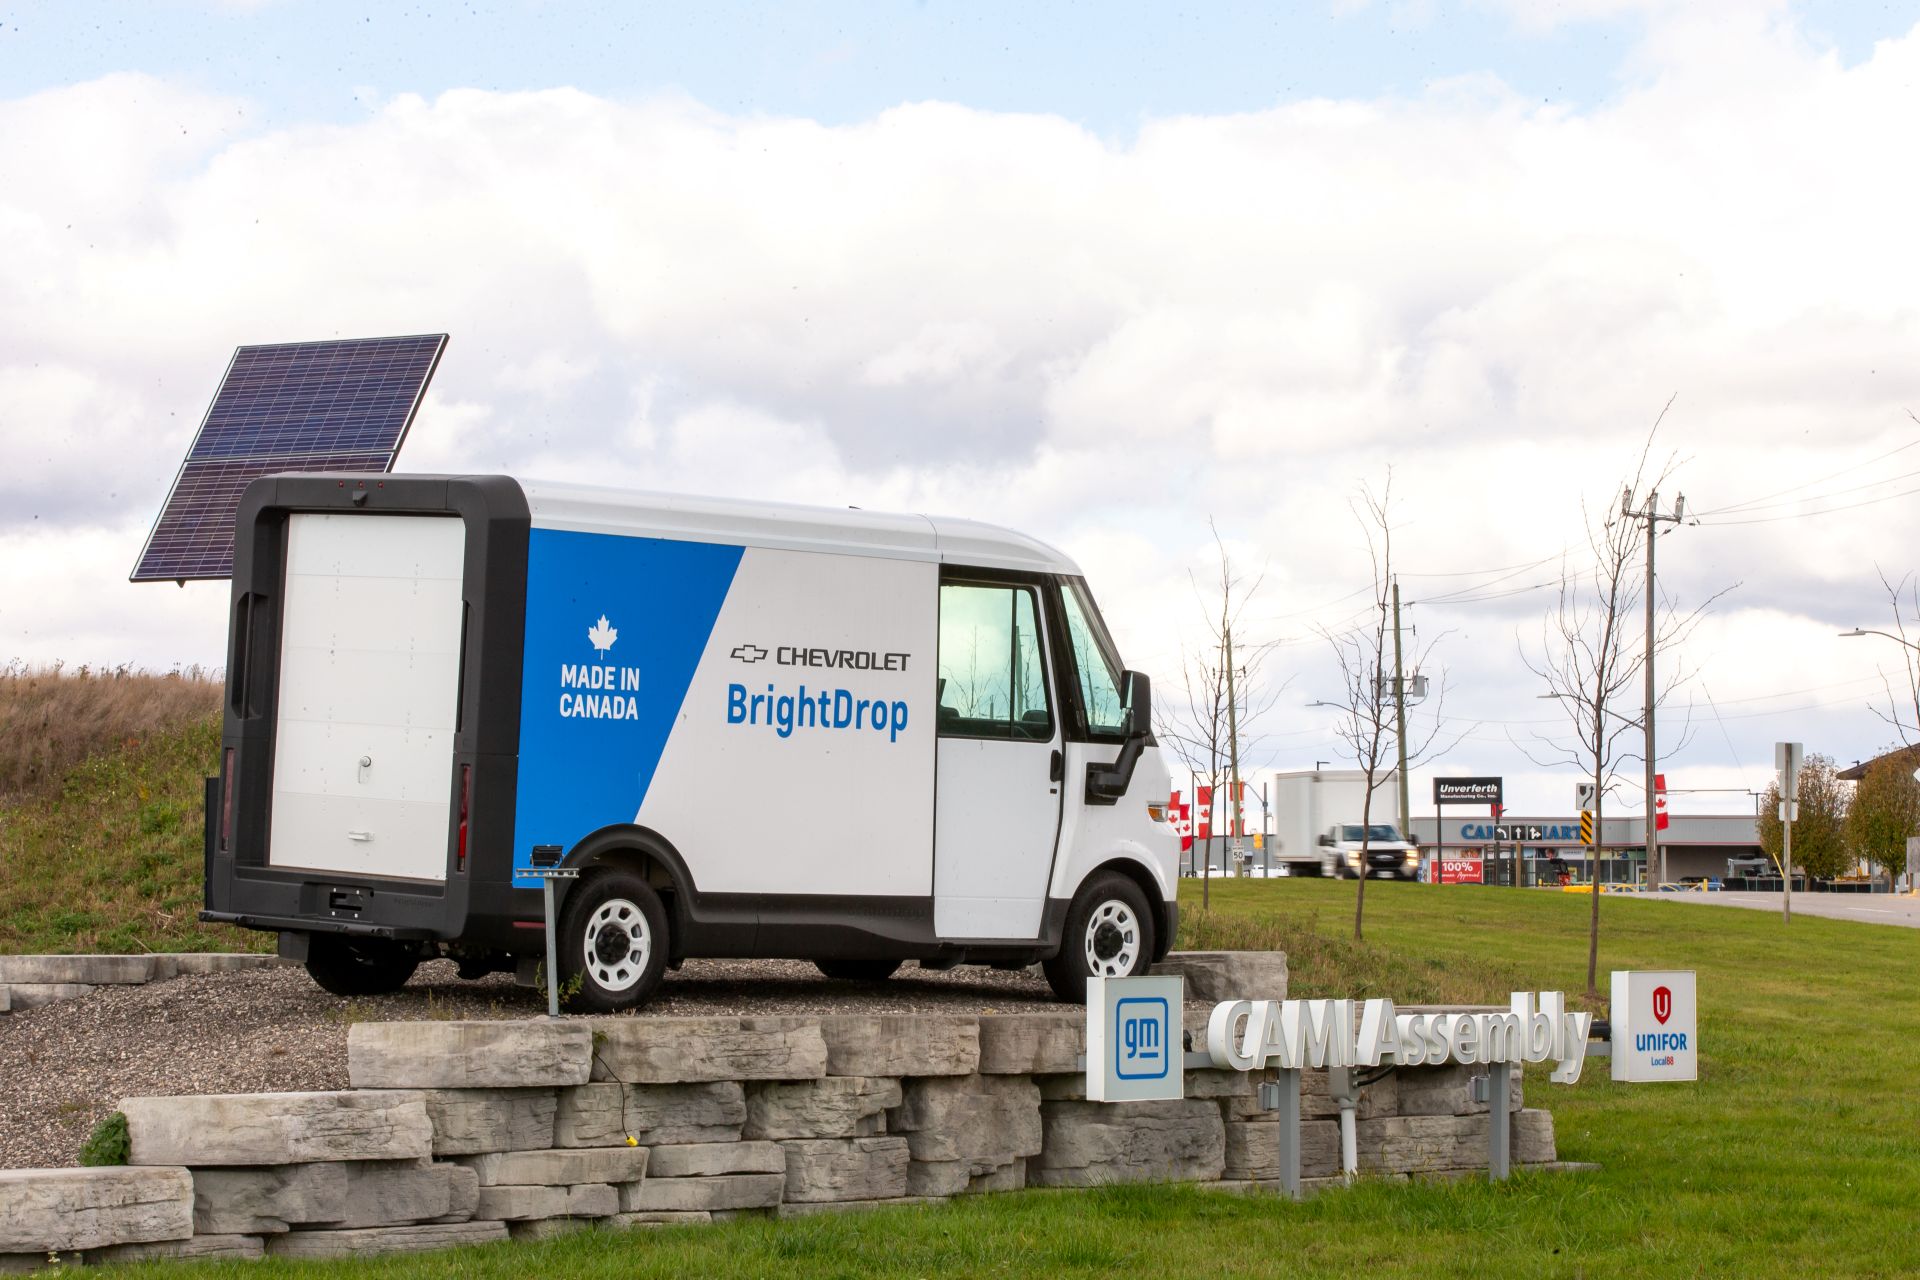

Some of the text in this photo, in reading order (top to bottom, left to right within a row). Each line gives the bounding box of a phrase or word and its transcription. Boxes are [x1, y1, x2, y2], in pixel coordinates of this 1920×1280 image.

[776, 646, 911, 671] CHEVROLET
[561, 664, 640, 692] MADE IN
[559, 693, 639, 720] CANADA
[727, 683, 909, 743] BrightDrop
[1440, 784, 1498, 793] Unverferth
[1233, 851, 1244, 859] 50
[1442, 862, 1473, 872] 100%
[1125, 1018, 1159, 1059] gm
[1208, 991, 1593, 1085] CAMI Assembly
